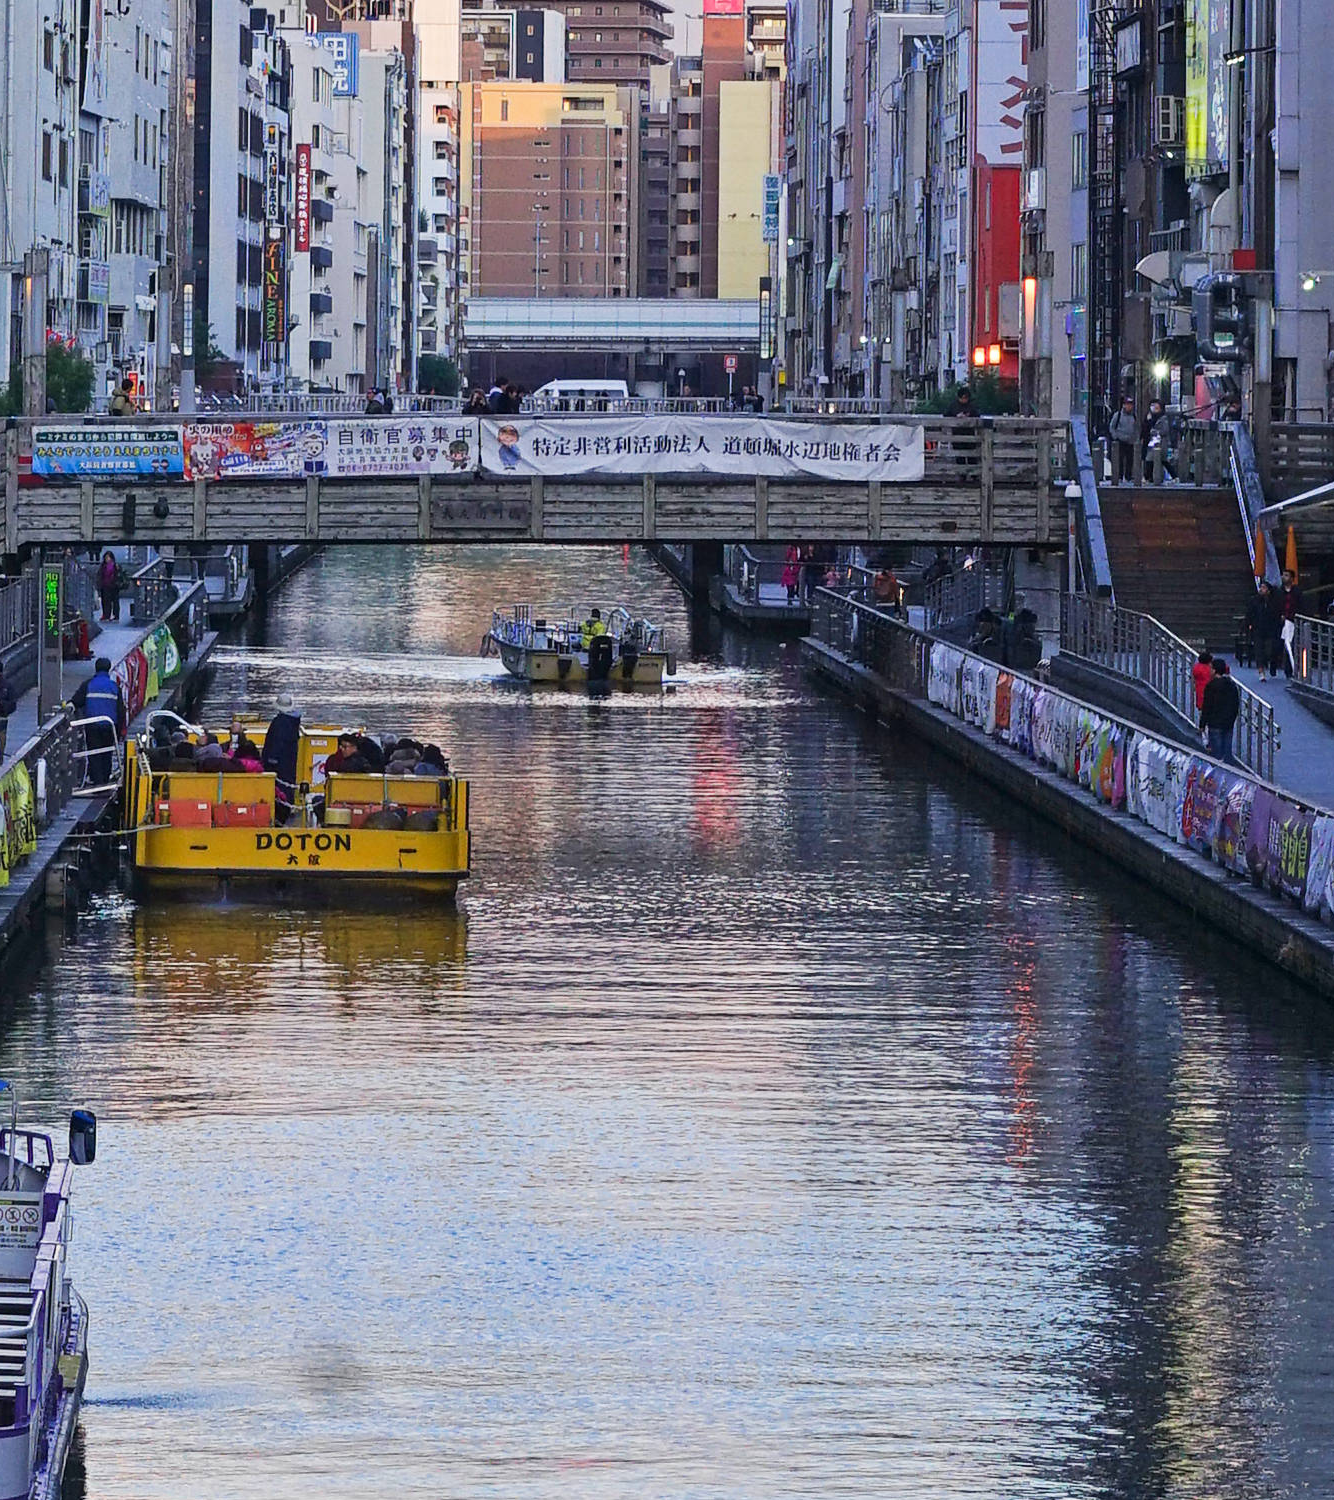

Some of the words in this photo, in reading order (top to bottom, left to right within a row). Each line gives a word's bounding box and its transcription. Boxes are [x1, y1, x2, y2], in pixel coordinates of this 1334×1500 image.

[337, 425, 474, 447] 自衛官募集中
[531, 434, 711, 459] 特定非営利活動法人
[255, 832, 352, 851] DOTON
[286, 853, 321, 867] 大阪
